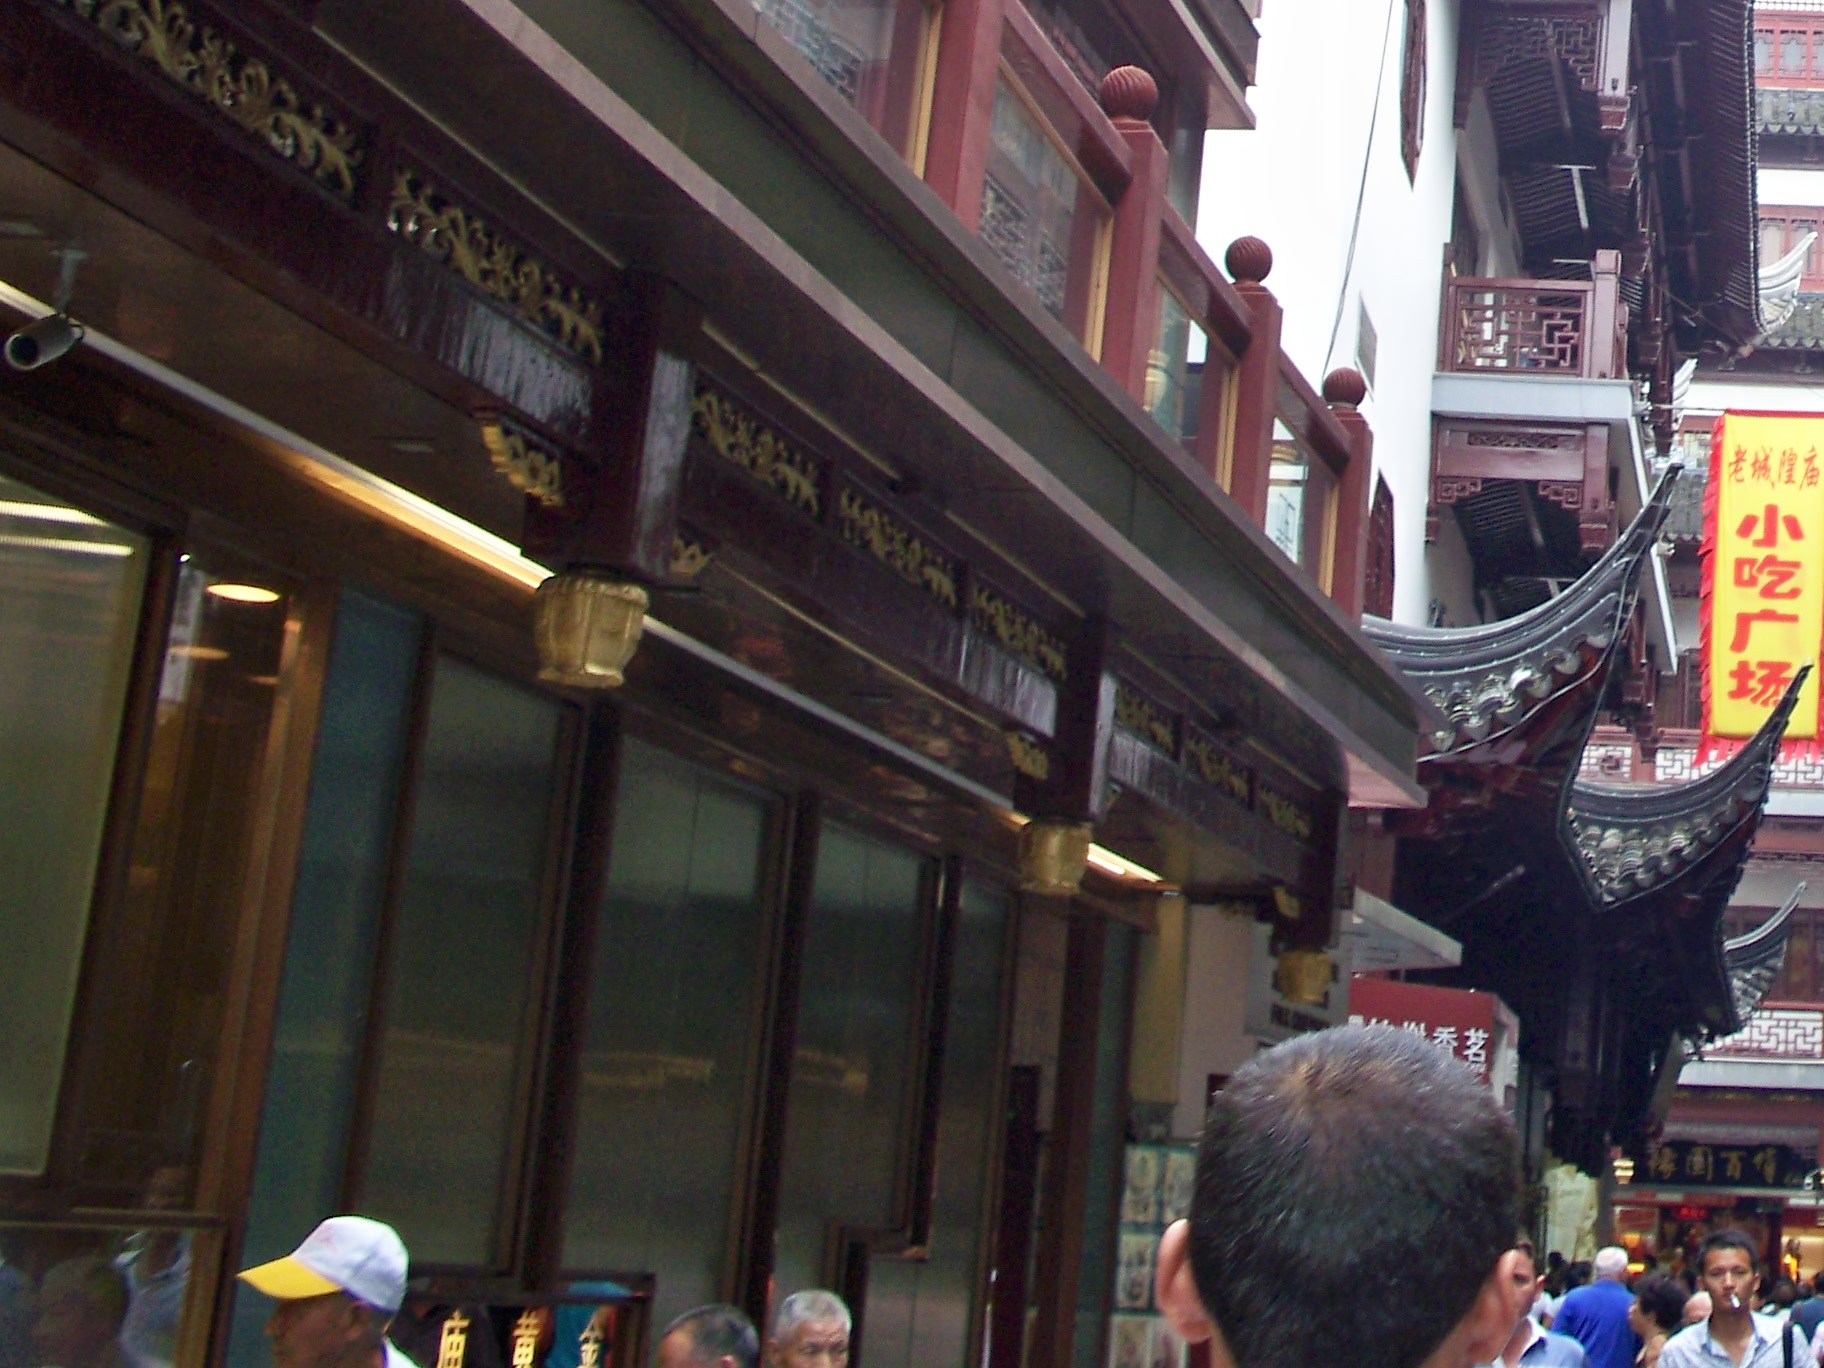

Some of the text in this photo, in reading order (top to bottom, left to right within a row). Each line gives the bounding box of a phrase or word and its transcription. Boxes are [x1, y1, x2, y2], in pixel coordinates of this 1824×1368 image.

[1728, 444, 1821, 490] 老城隍庙
[1729, 504, 1805, 709] 小吃广场
